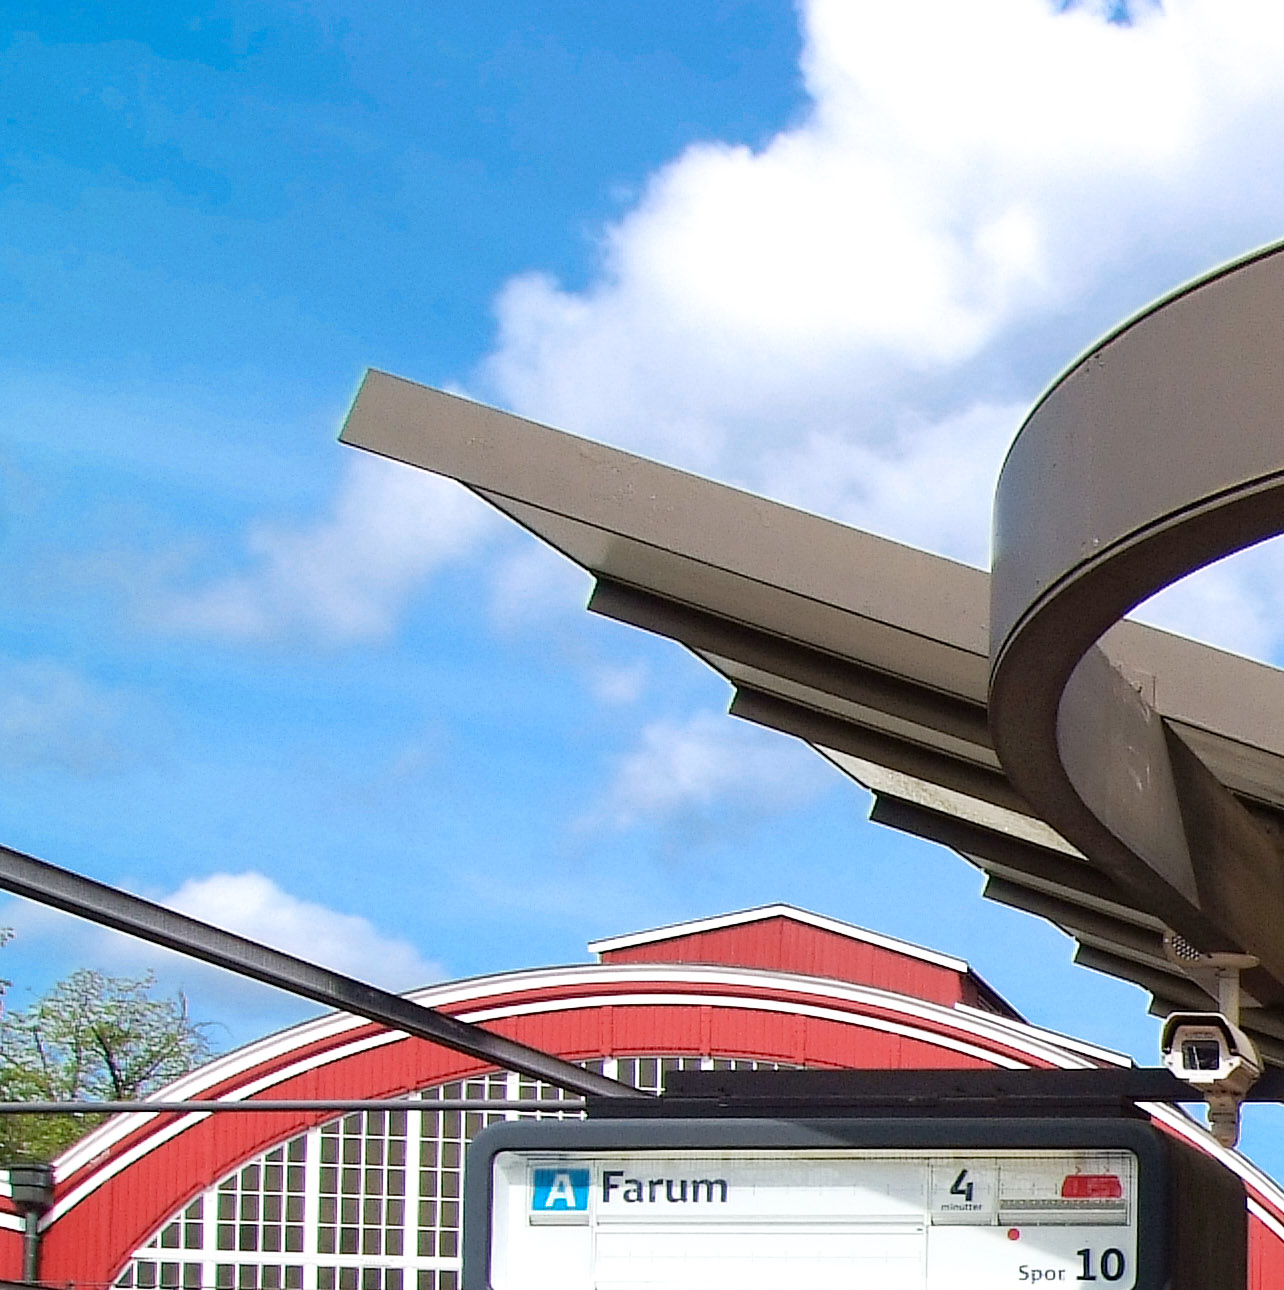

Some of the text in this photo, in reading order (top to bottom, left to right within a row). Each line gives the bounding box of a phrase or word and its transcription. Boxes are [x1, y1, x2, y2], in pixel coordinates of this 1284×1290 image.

[545, 1170, 728, 1208] A Farum
[950, 1169, 973, 1201] 4
[1018, 1248, 1126, 1284] Spor 10
